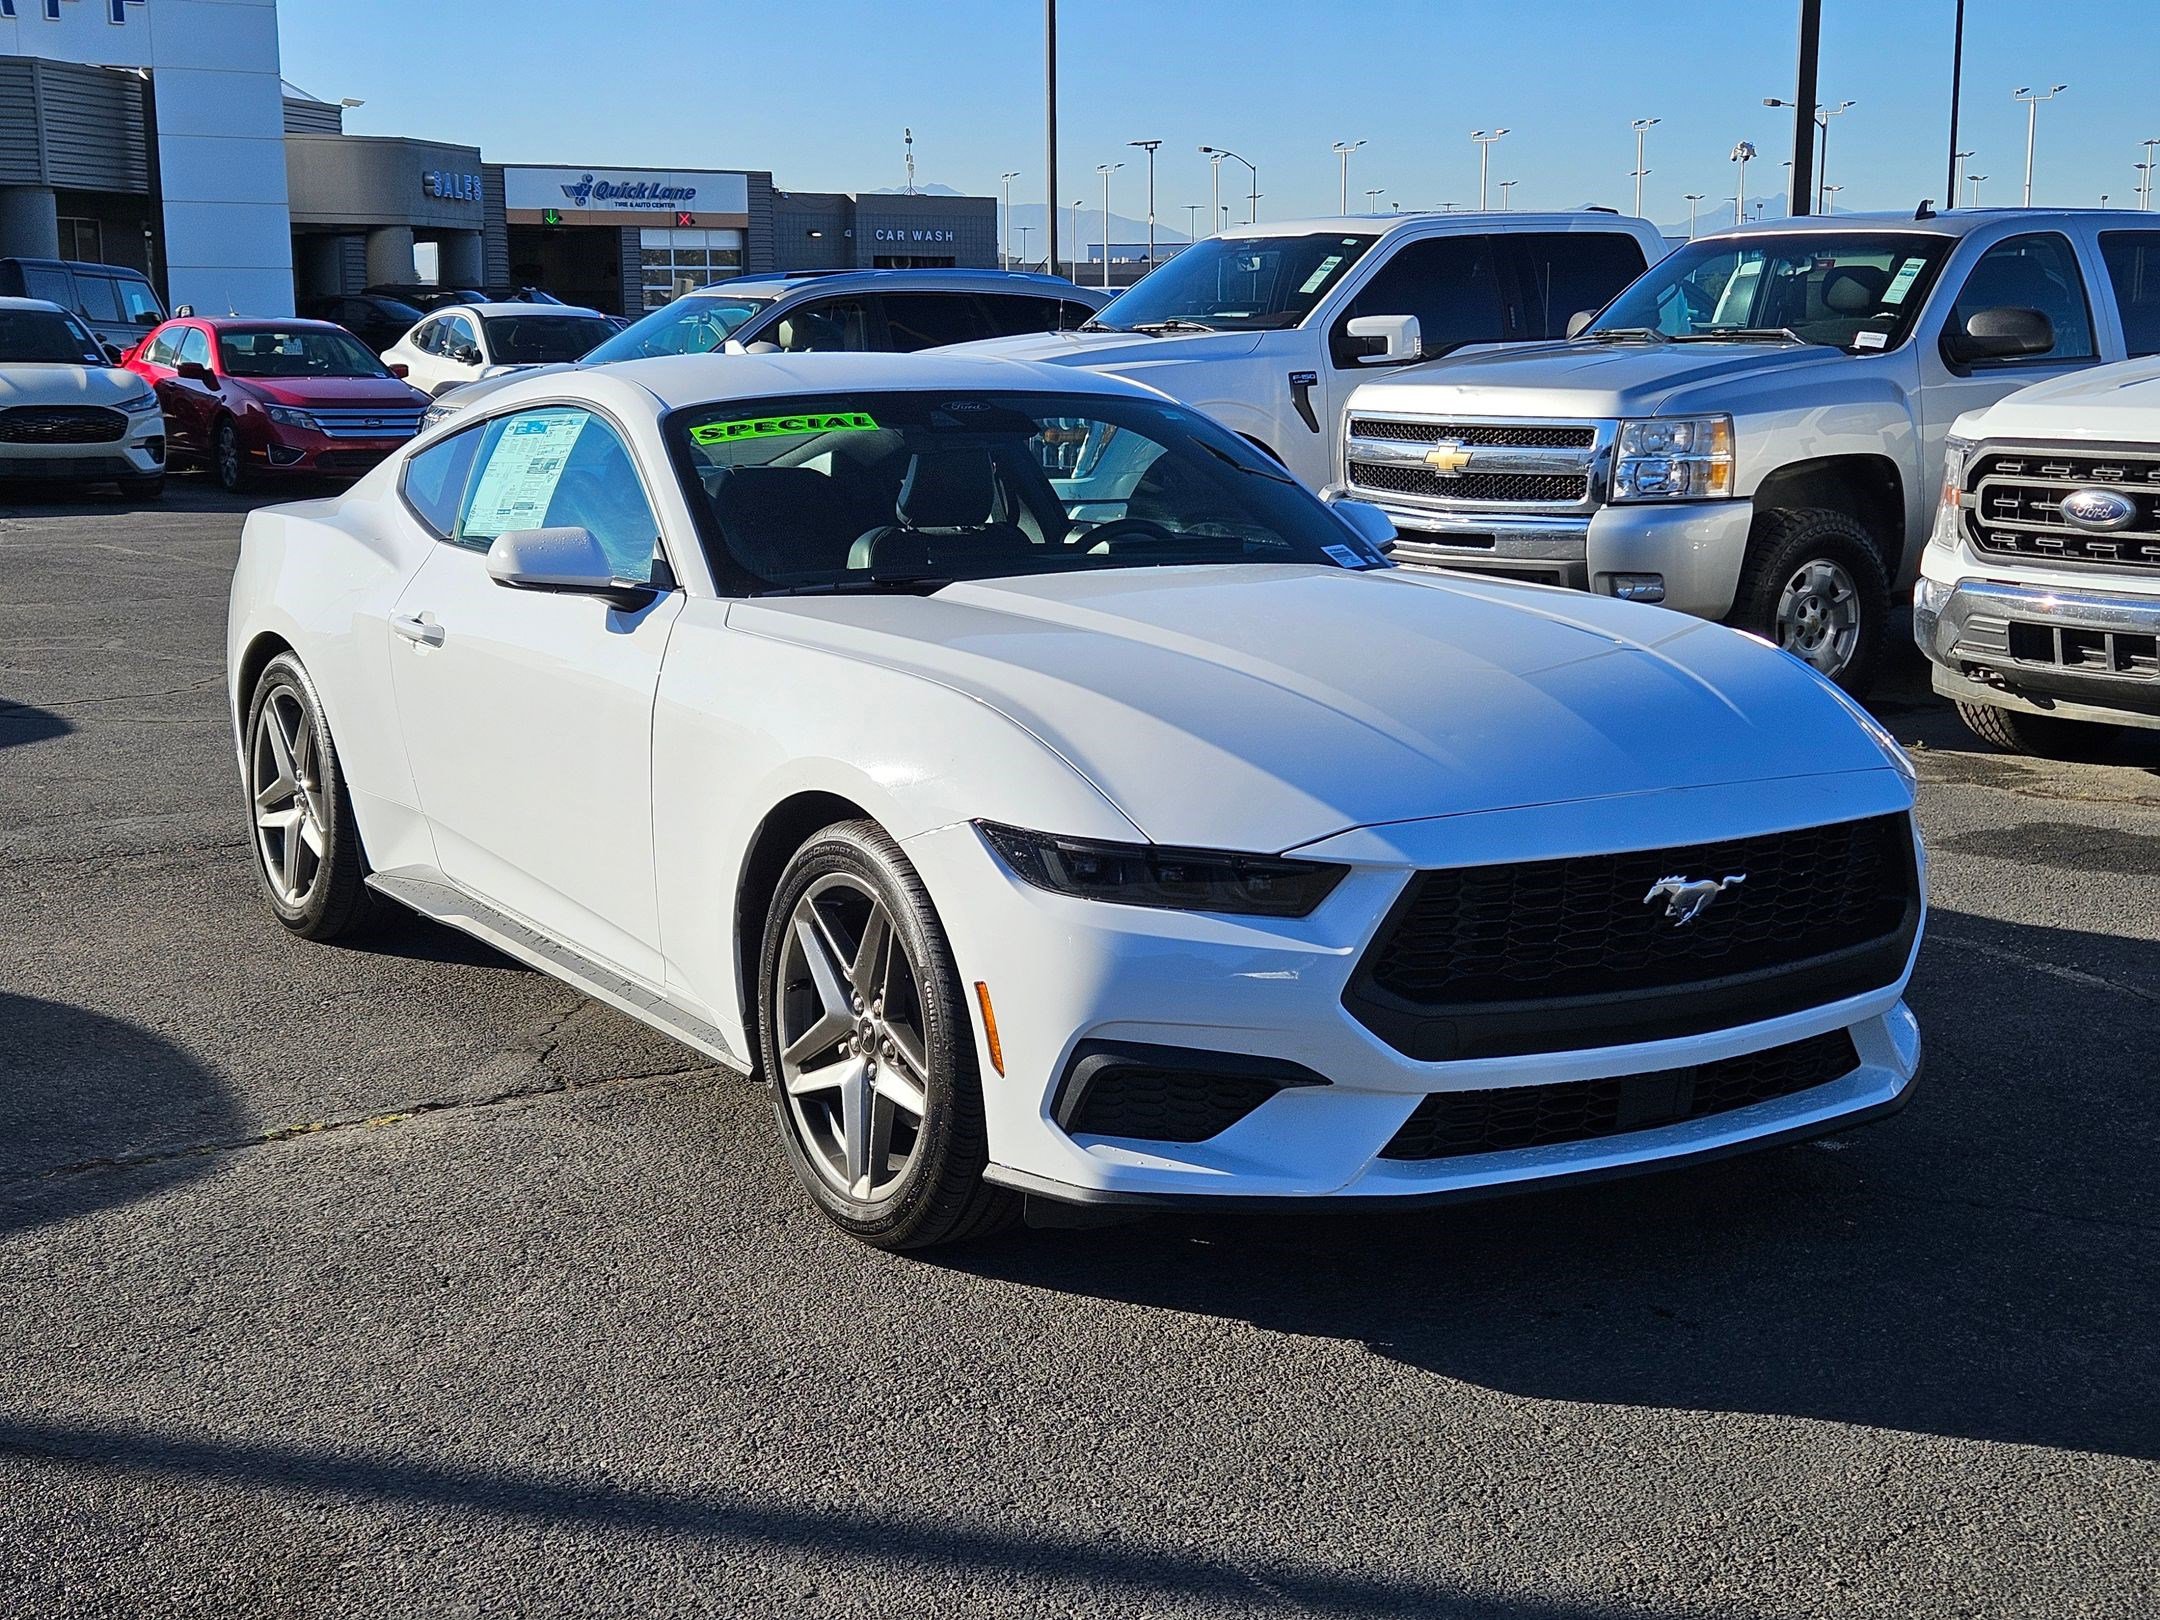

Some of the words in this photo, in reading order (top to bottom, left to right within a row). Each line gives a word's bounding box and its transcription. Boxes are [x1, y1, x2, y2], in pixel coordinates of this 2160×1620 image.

[433, 170, 481, 200] SALES
[875, 229, 905, 241] CAR
[912, 230, 953, 242] WASH
[699, 415, 870, 440] SPECIAL
[2072, 502, 2113, 519] Ford
